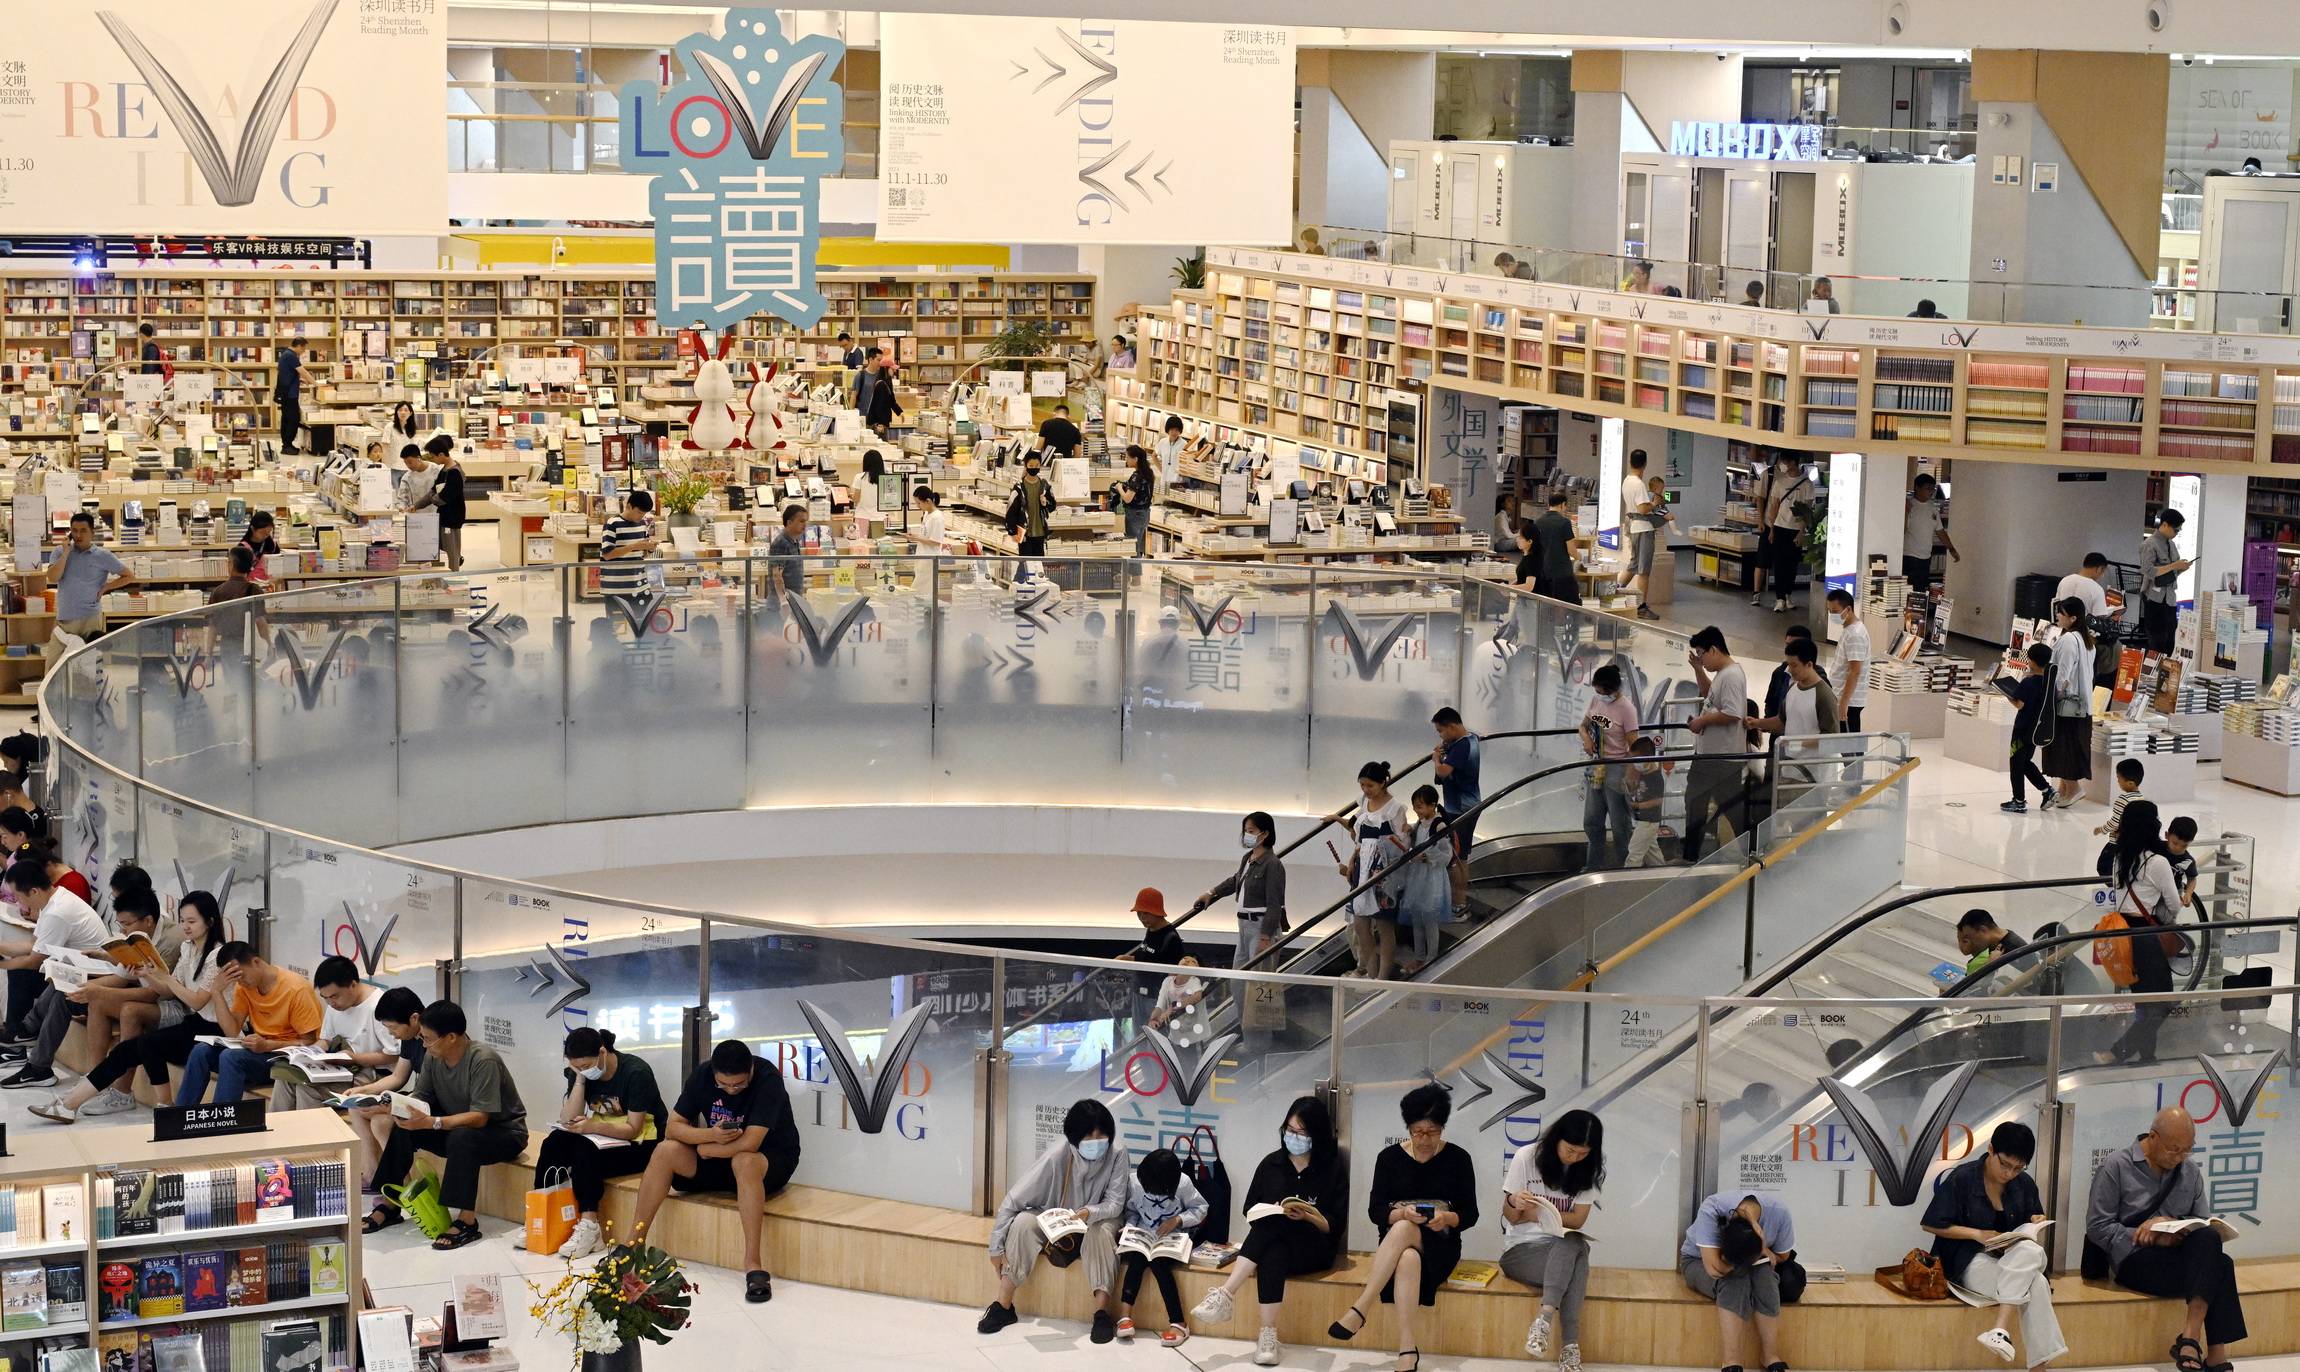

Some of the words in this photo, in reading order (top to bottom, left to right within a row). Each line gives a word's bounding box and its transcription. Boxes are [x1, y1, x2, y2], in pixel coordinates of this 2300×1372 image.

[377, 16, 422, 26] Shenzhen
[361, 25, 398, 36] Reading
[399, 26, 429, 35] Month
[1223, 29, 1286, 46] 深圳读书月
[1238, 47, 1275, 57] Shenzhen
[1224, 56, 1254, 66] Reading
[1255, 57, 1280, 65] Month
[634, 51, 829, 160] LOVE
[889, 109, 914, 118] linking
[915, 109, 948, 118] HISTORY
[906, 117, 951, 126] MODERNITY
[1671, 120, 1800, 161] MOBOX
[1837, 187, 1847, 257] MOBOX
[213, 242, 332, 256] 乐客VR科技娱乐空间
[532, 898, 550, 908] BOOK
[1464, 1002, 1489, 1010] BOOK
[1820, 1014, 1846, 1023] BOOK
[1101, 1025, 1239, 1107] LOVE
[185, 1106, 236, 1122] 日本小说
[183, 1122, 216, 1131] JAPANESE
[216, 1120, 238, 1128] NOVEL
